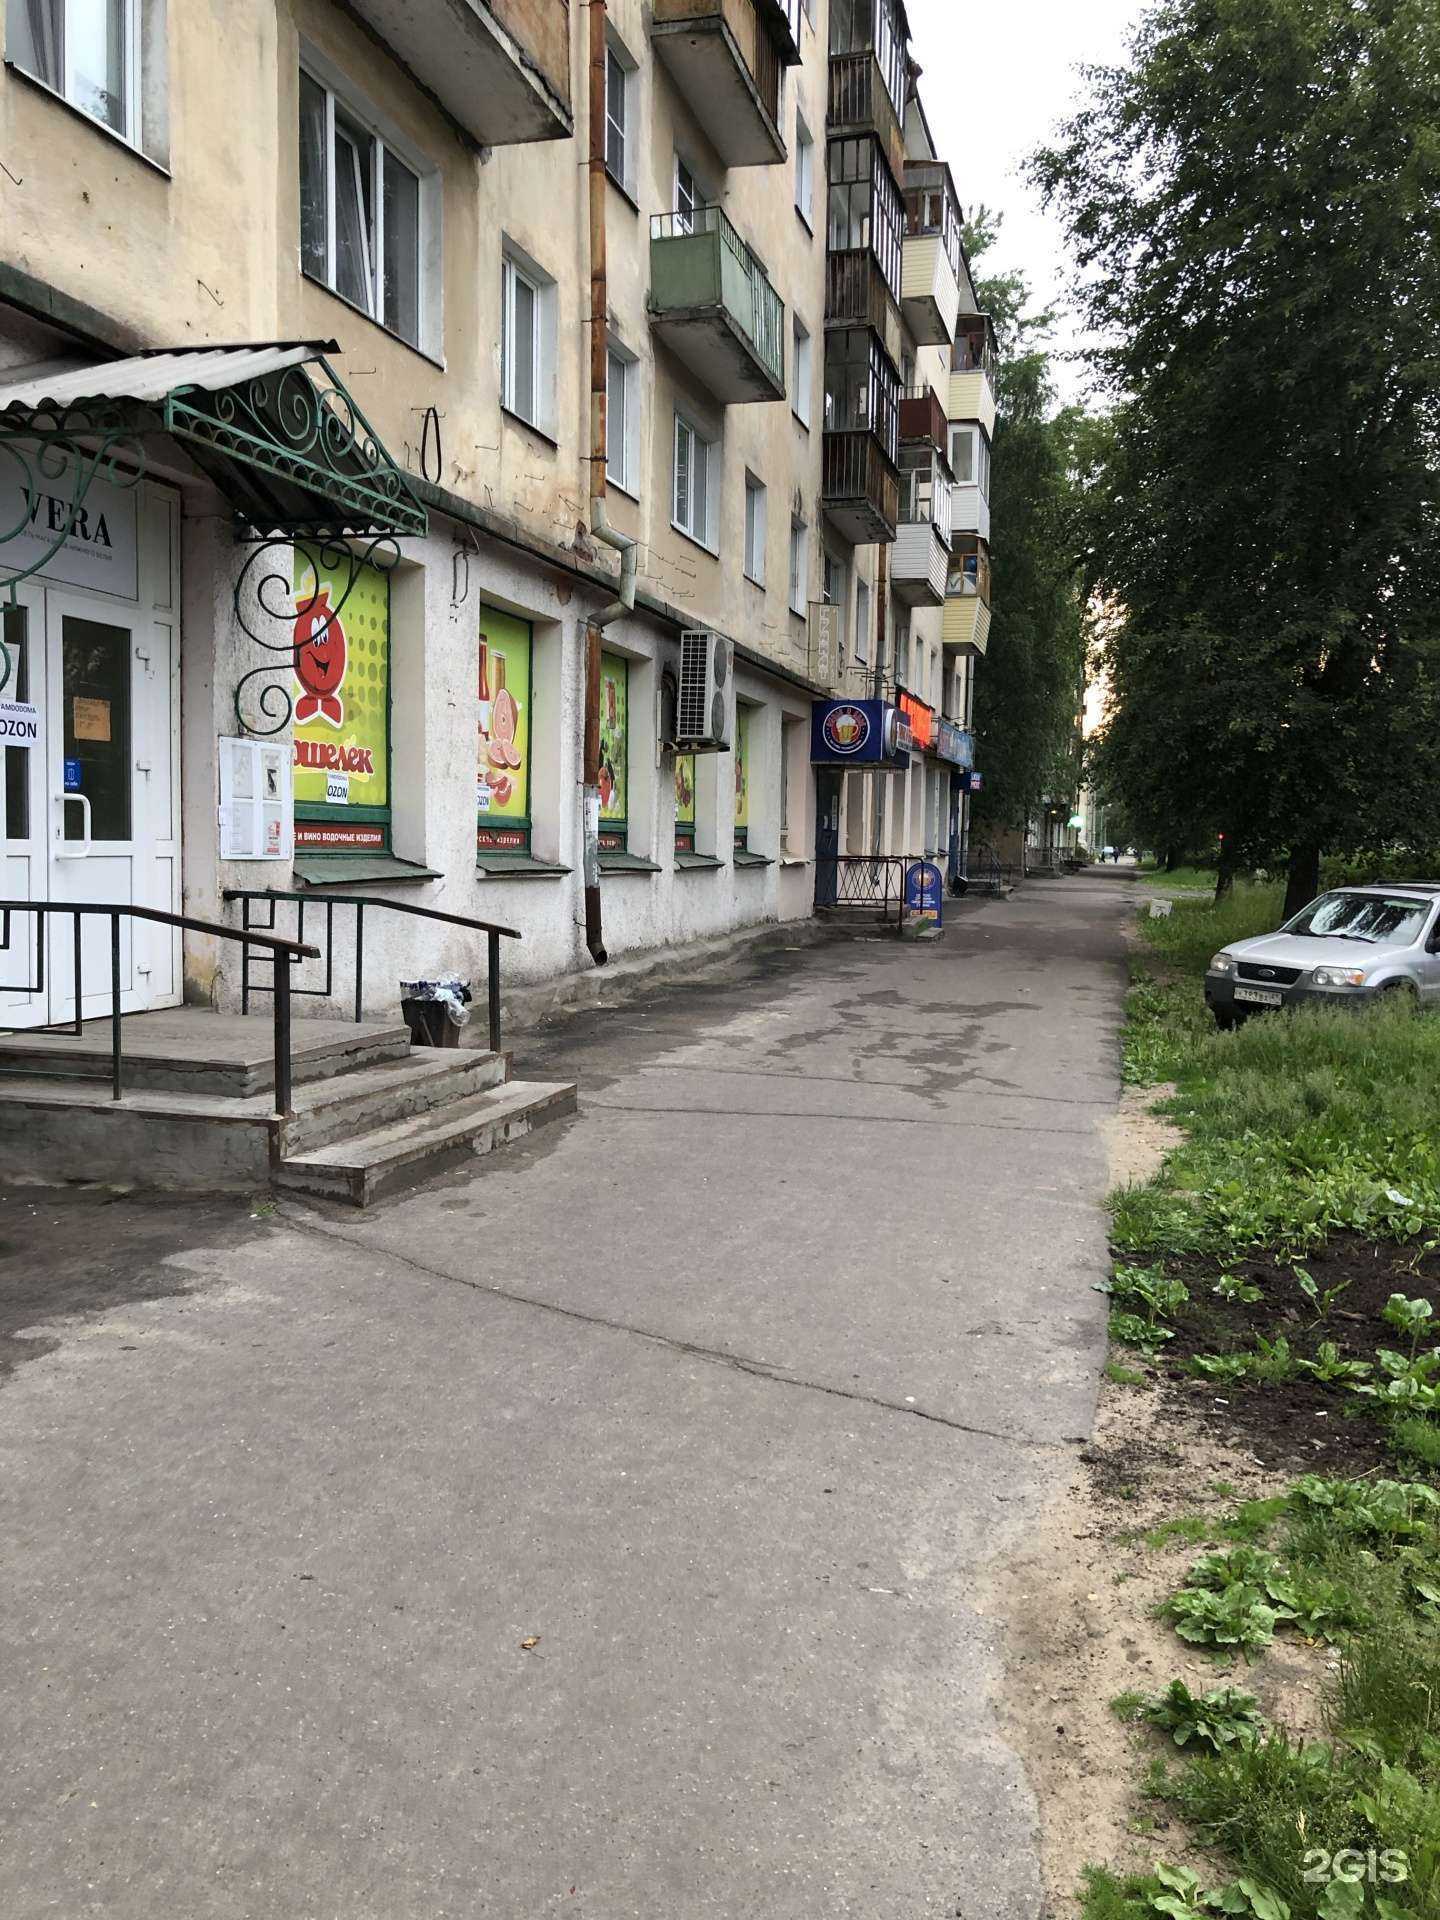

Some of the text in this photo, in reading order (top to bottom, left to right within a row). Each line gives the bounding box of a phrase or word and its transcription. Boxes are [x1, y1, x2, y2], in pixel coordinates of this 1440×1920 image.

[20, 486, 112, 548] VERA
[0, 719, 37, 739] OZON
[327, 785, 348, 799] OZON
[304, 832, 321, 841] ВИНО
